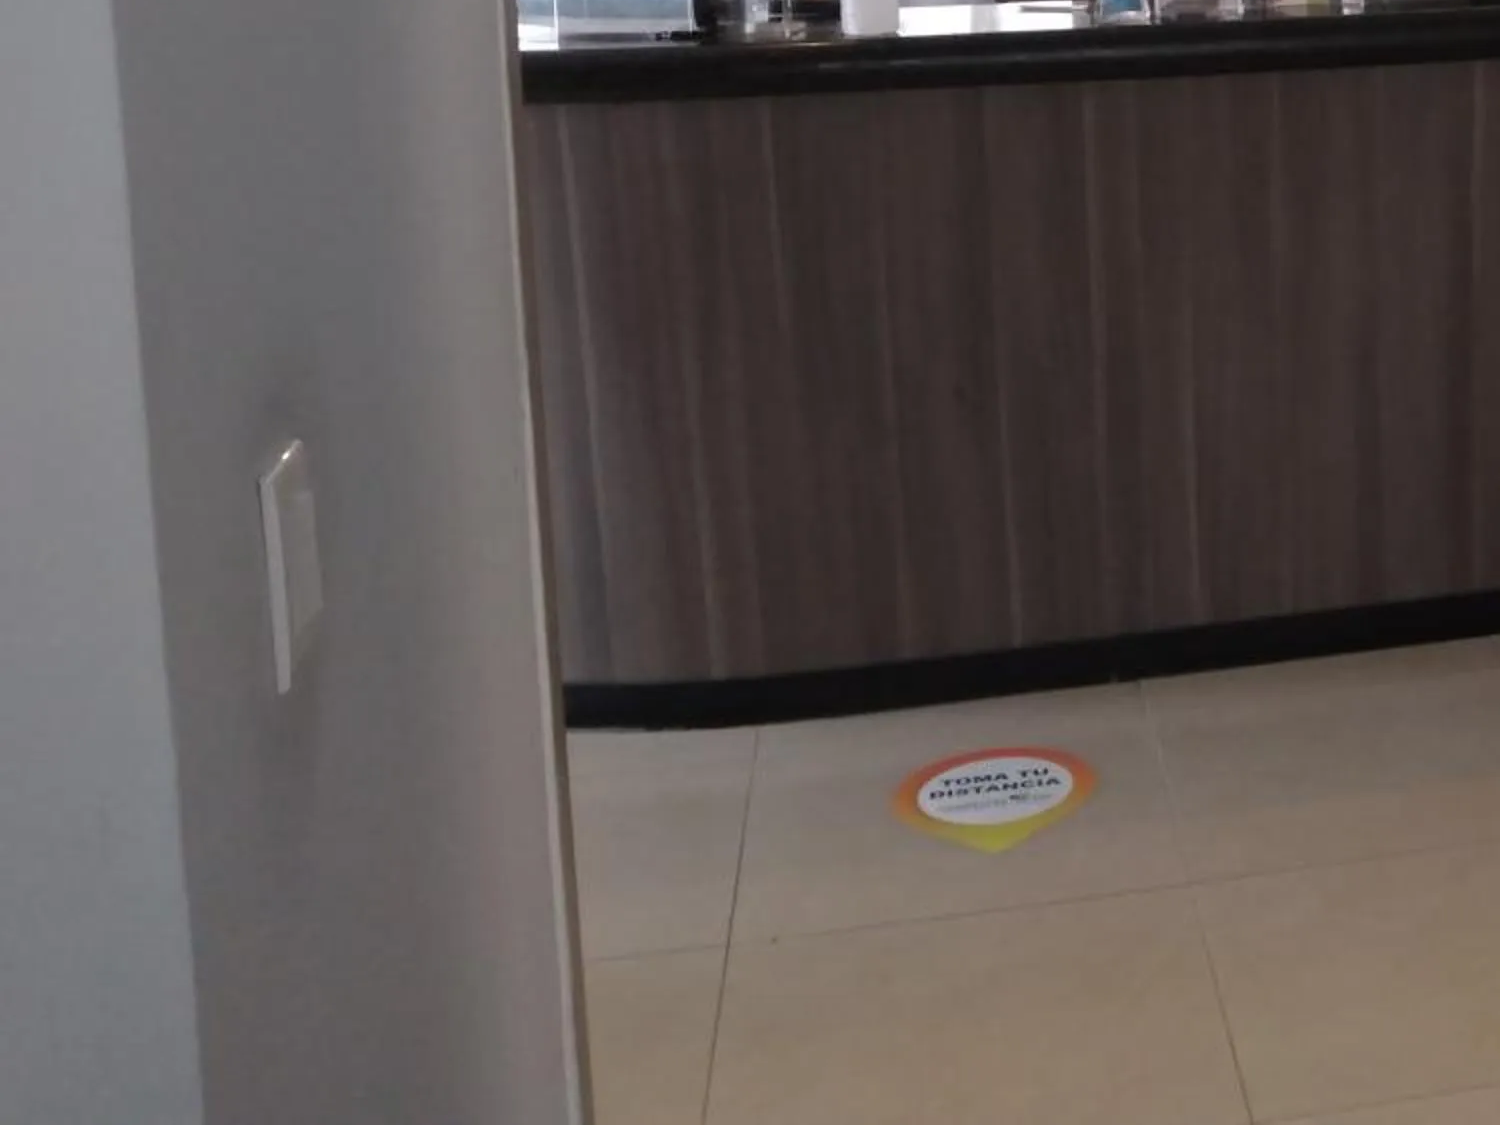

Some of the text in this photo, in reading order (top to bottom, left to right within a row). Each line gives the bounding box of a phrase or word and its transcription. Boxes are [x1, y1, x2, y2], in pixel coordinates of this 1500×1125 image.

[941, 768, 1049, 787] TOMA TU
[929, 778, 1061, 800] DISTANCIA
